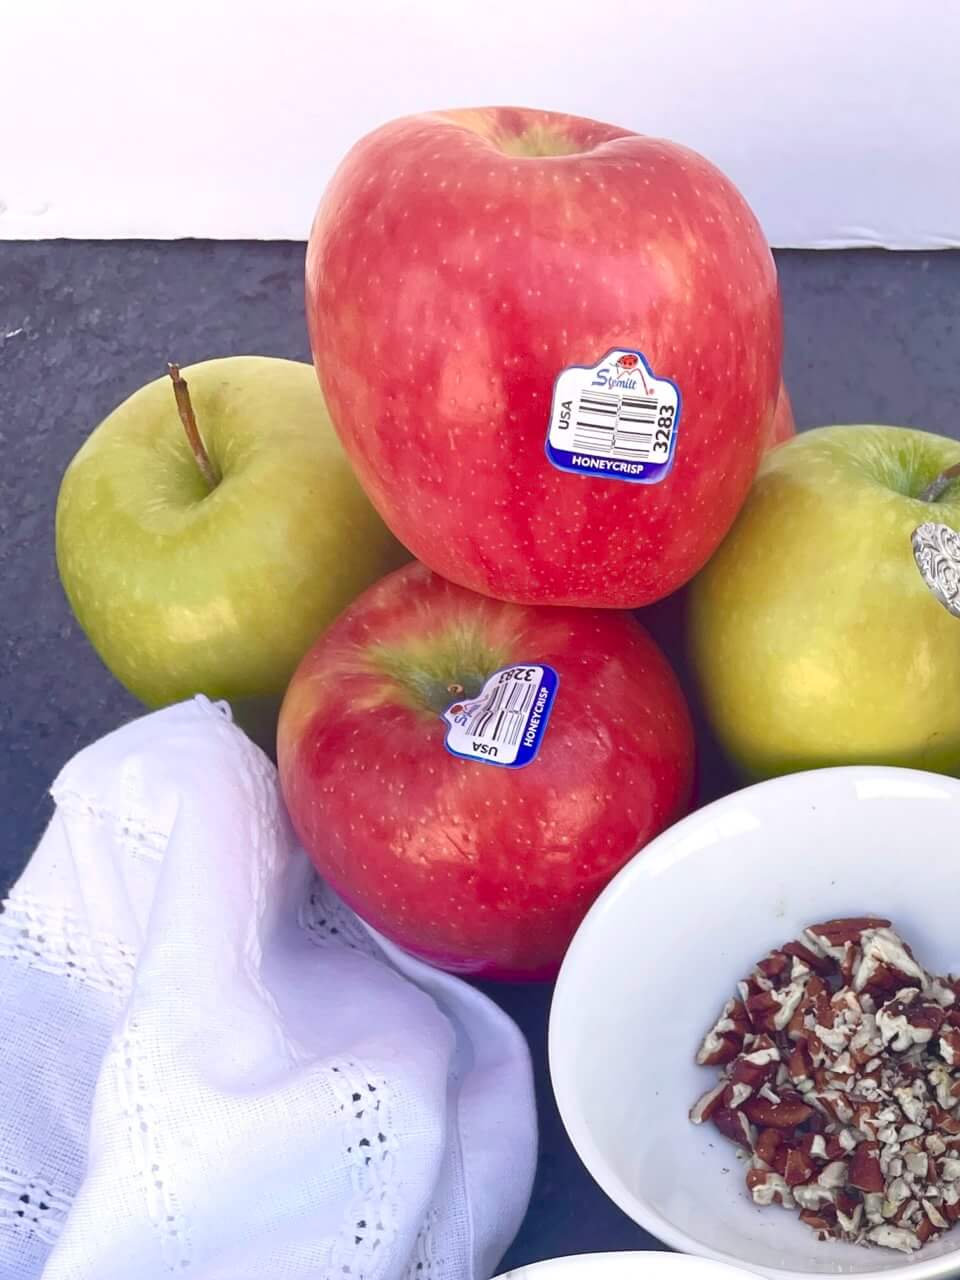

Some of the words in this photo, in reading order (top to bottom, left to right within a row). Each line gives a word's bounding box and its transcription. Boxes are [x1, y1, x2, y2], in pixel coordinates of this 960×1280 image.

[592, 368, 637, 390] Stemilt
[558, 400, 573, 430] USA
[653, 405, 675, 453] 3283
[572, 455, 644, 475] HONEYCRISP
[523, 687, 549, 747] HONEYCRISP
[472, 741, 498, 757] USA
